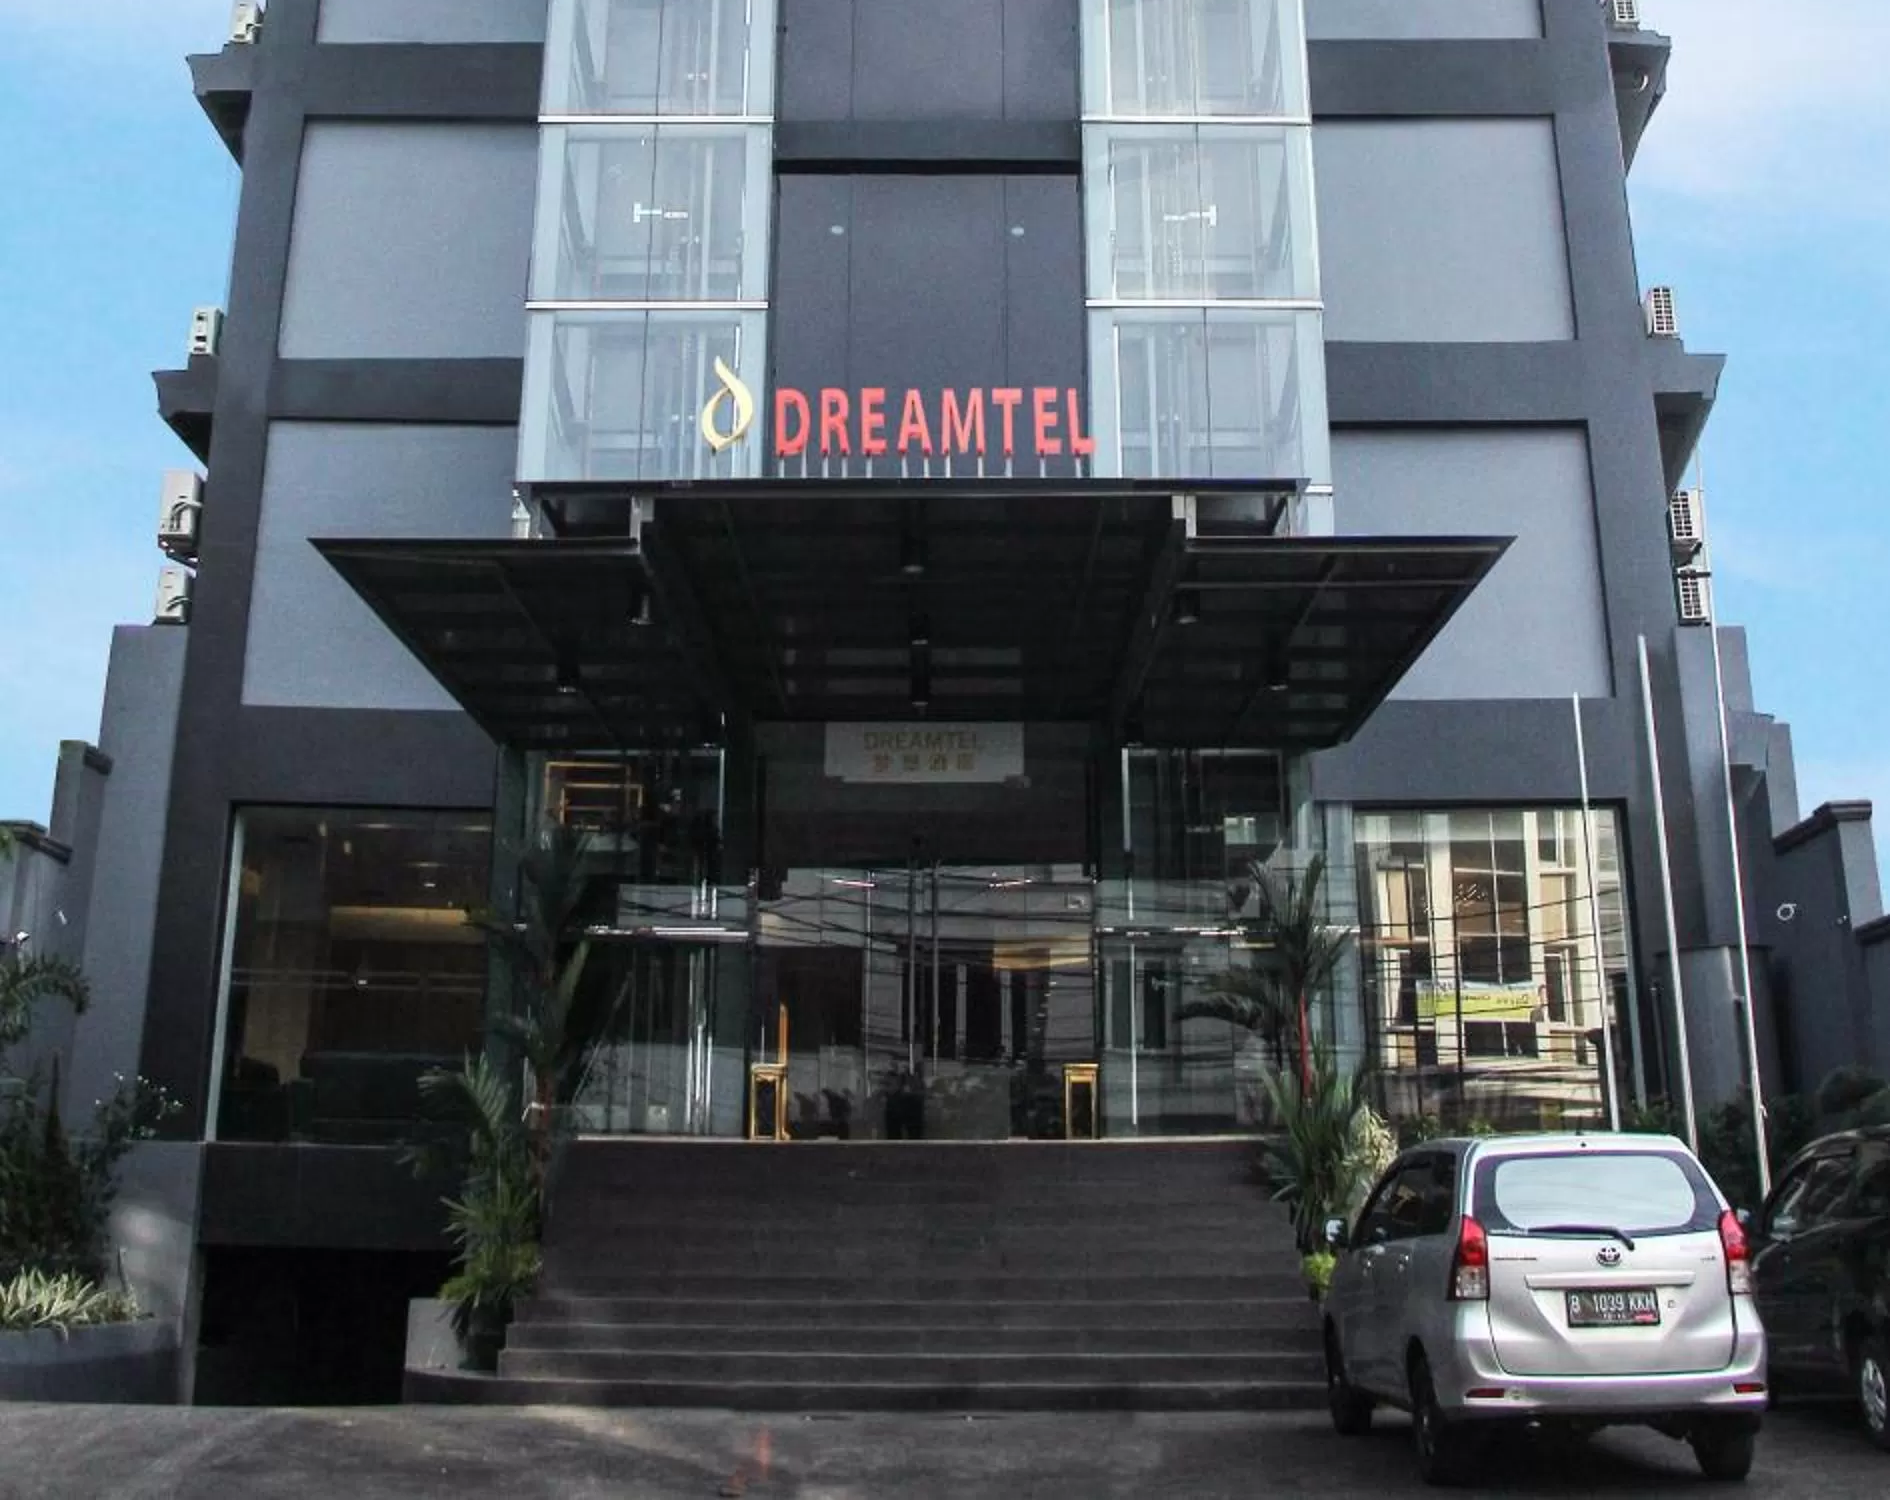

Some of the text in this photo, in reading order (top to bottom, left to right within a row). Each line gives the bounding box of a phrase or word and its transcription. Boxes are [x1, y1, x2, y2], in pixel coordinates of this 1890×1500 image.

[775, 387, 1096, 456] DREAMTEL
[1570, 1294, 1581, 1313] B
[1592, 1293, 1625, 1312] 1039
